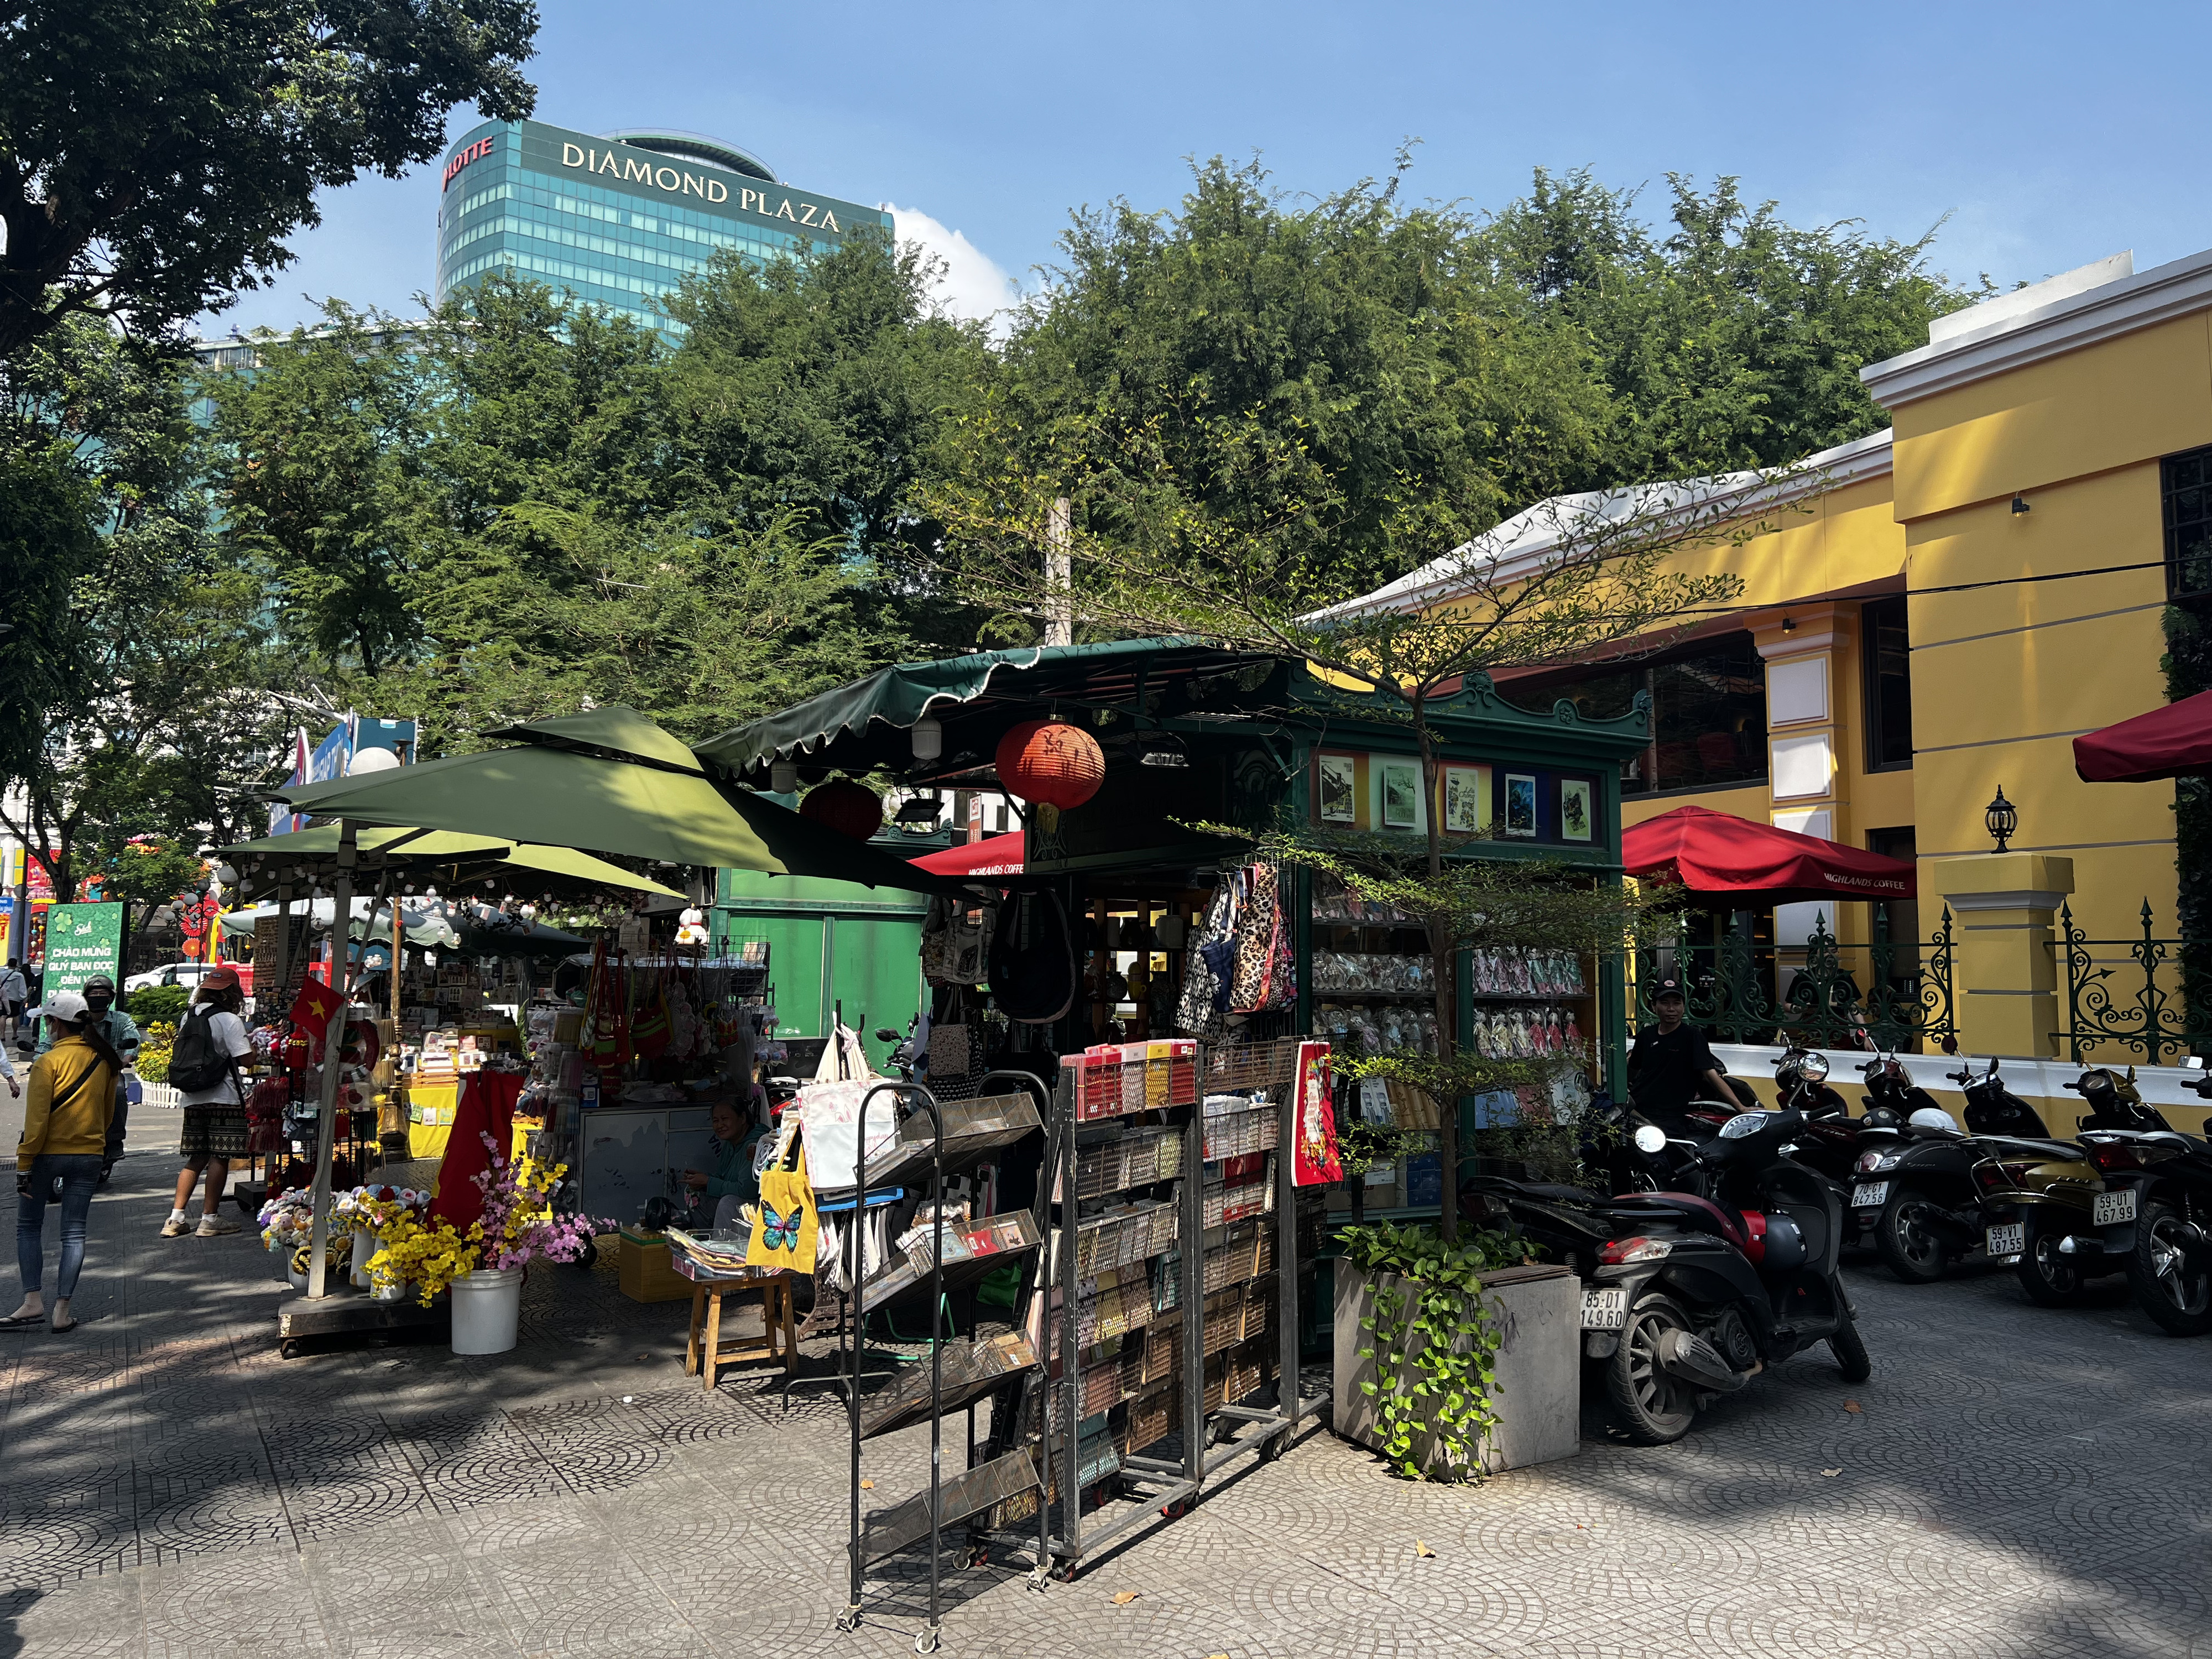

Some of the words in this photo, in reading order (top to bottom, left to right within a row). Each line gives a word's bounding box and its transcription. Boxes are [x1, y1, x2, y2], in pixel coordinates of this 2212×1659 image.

[448, 136, 493, 180] LOTTE
[562, 142, 728, 203] DIAMOND
[739, 187, 839, 233] PLAZA
[968, 865, 1004, 875] HIGHLANDS
[1004, 864, 1024, 874] COFFE
[1824, 872, 1872, 887] HIGHLANDS
[1874, 879, 1906, 890] COFFEE
[52, 945, 80, 957] CHÀO
[81, 945, 111, 957] MỪNG
[48, 959, 69, 971] QUÝ
[71, 962, 91, 973] BẠN
[93, 961, 114, 972] ĐỌC
[60, 972, 81, 984] ĐẾN
[1859, 1183, 1882, 1195] 70-G1
[1853, 1193, 1883, 1206] 847.56
[2100, 1193, 2127, 1209] 59-U1
[2096, 1206, 2132, 1223] 467.99
[1992, 1225, 2017, 1240] 59-V1
[1989, 1238, 2022, 1254] 487.55
[1581, 1310, 1623, 1327] 149.60
